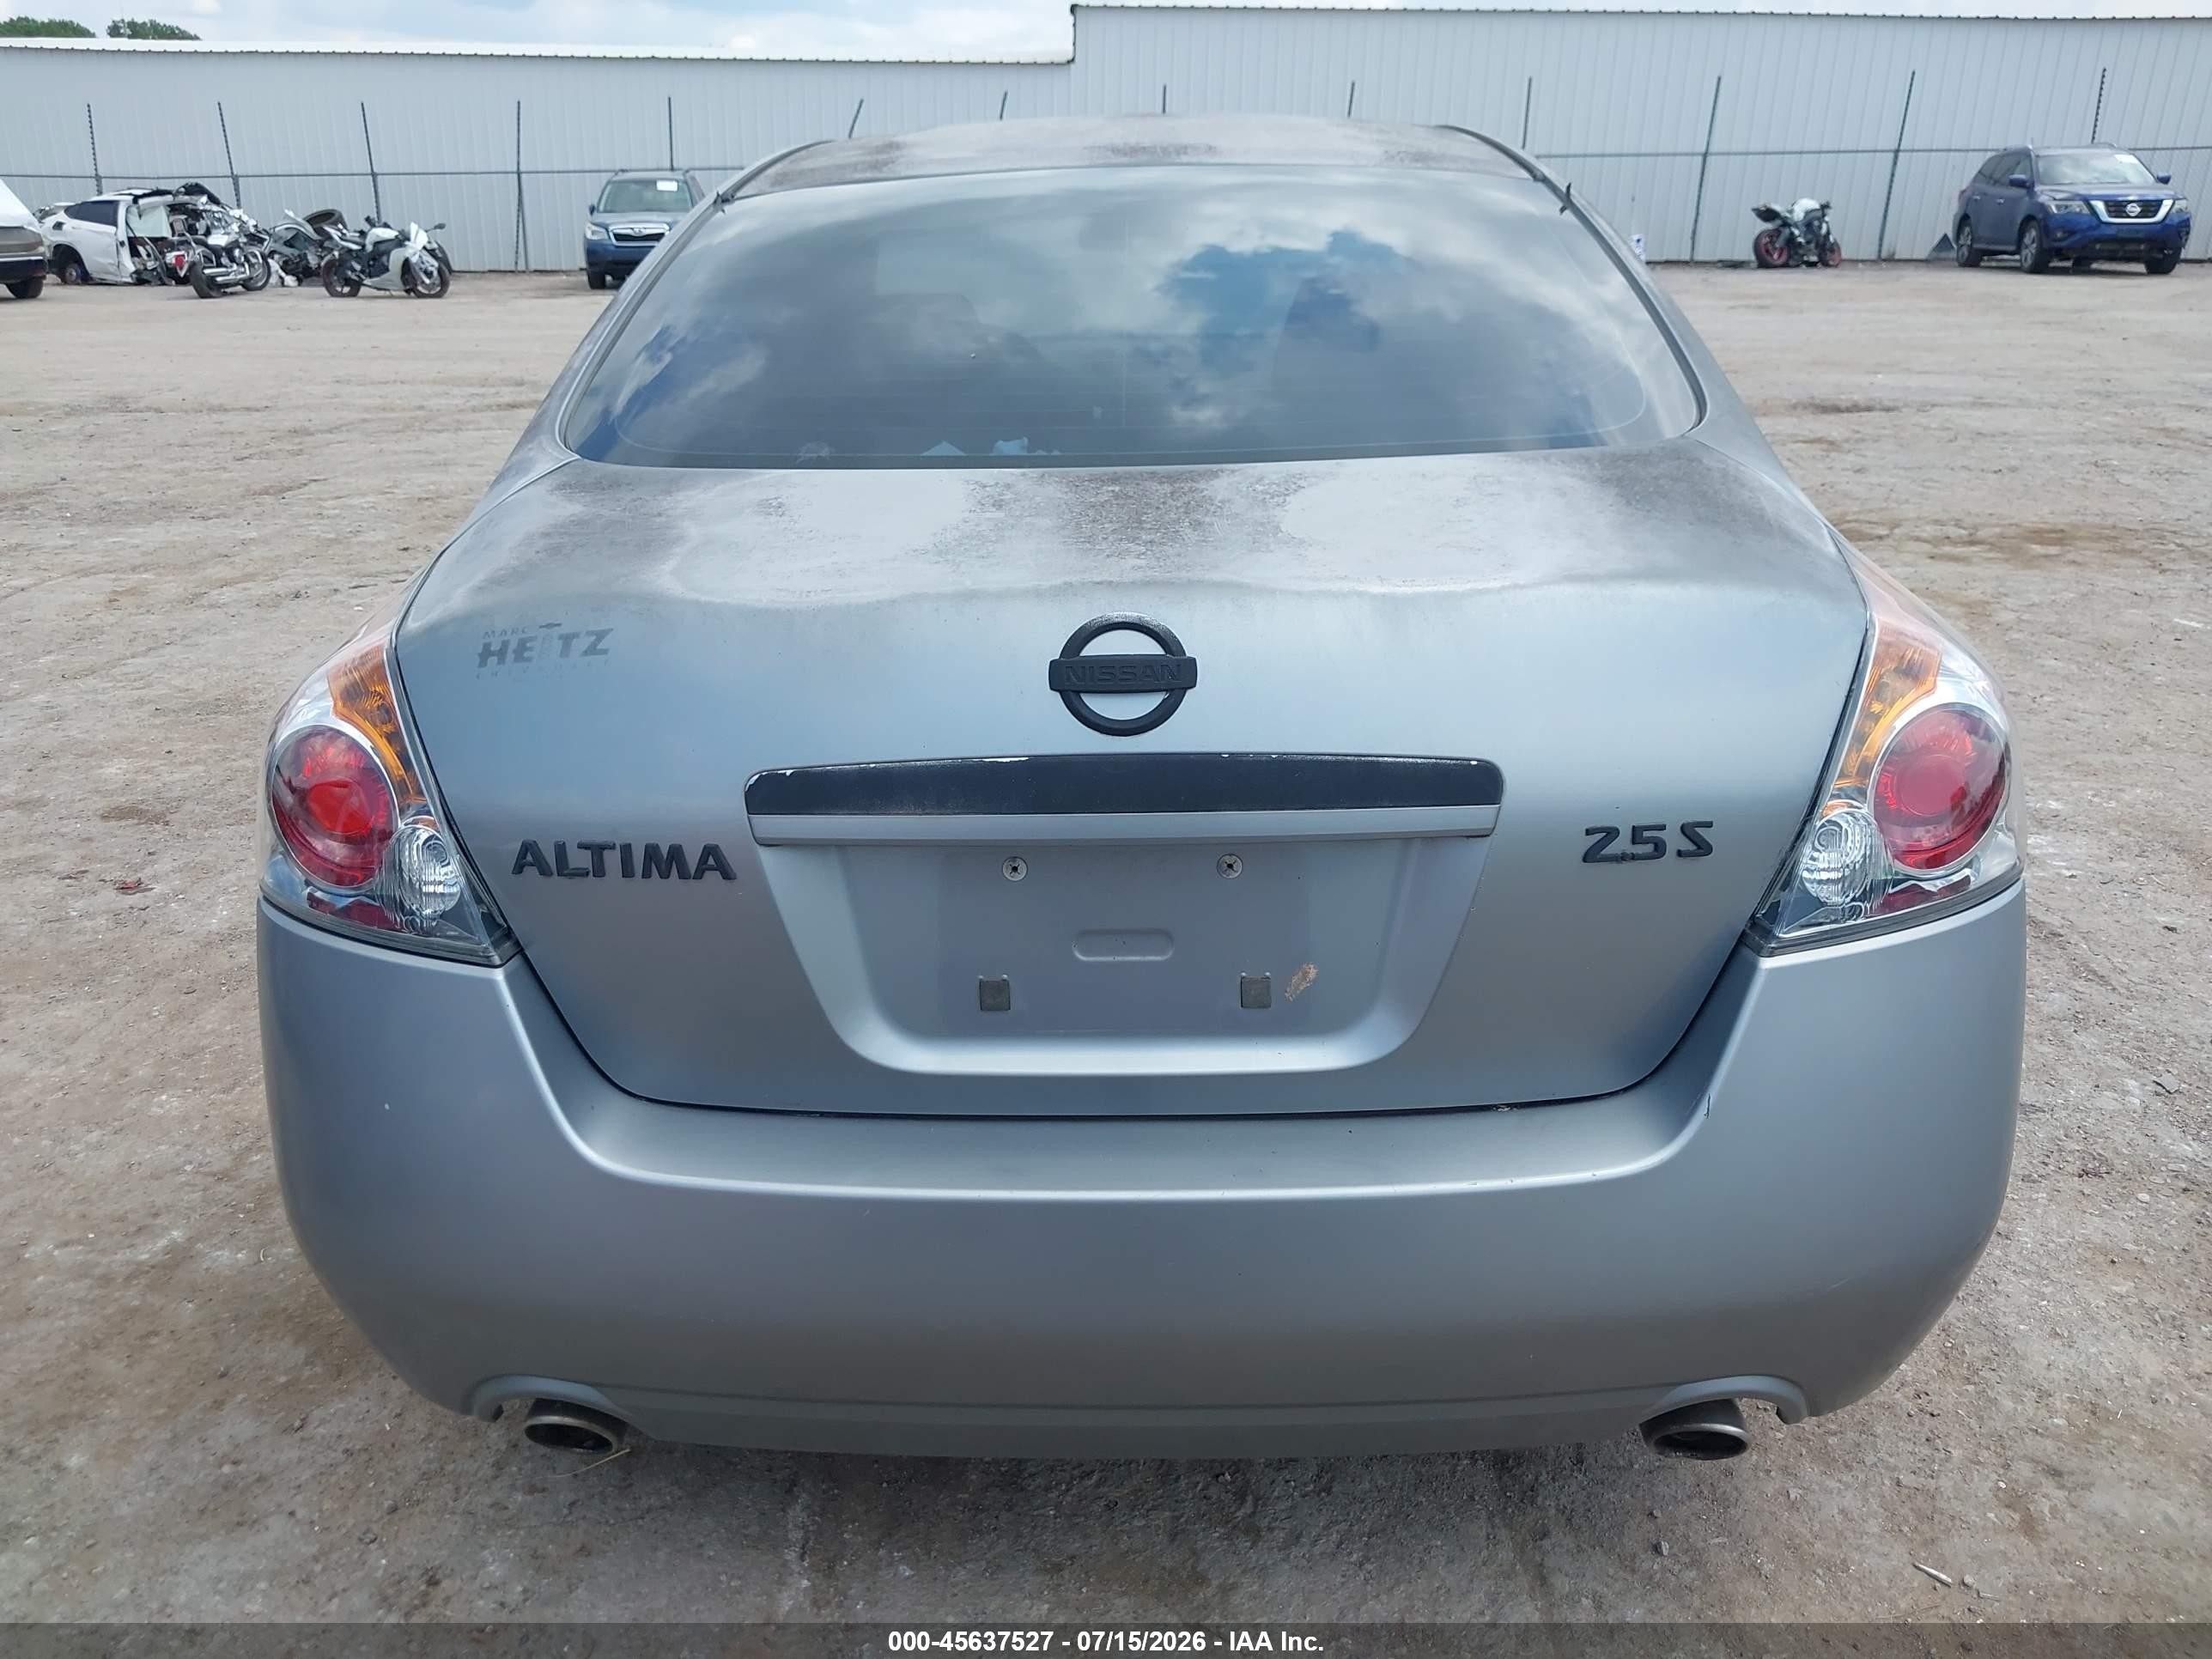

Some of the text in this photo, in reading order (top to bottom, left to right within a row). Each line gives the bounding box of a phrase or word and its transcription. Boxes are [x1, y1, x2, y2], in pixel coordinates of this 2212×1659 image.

[477, 628, 613, 668] HETZ
[1064, 664, 1182, 684] NISSAN
[511, 838, 738, 880] ALTIMA
